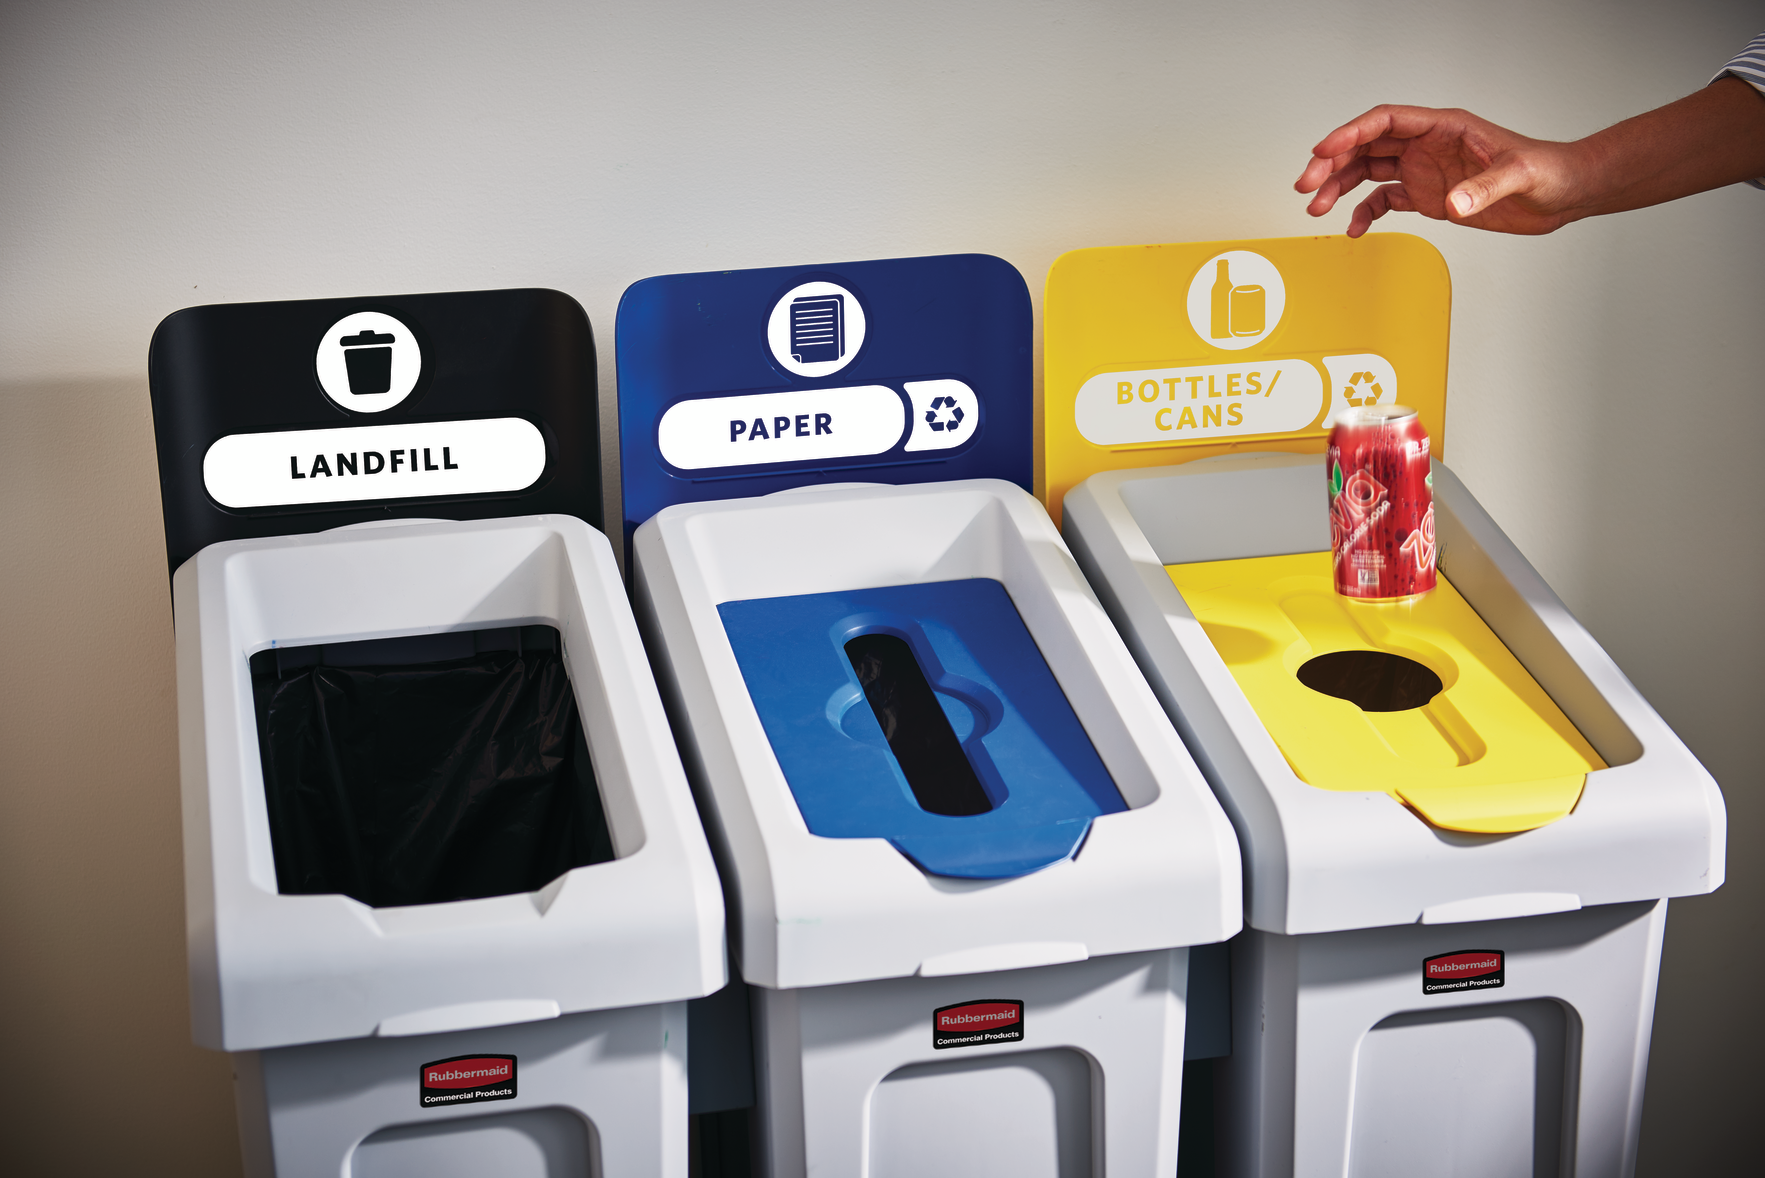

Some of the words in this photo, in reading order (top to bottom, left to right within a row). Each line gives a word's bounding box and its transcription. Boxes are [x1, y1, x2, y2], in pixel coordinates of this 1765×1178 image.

[1116, 369, 1283, 405] BOTTLES/
[1154, 402, 1244, 432] CANS
[729, 412, 833, 443] PAPER
[290, 446, 459, 480] LANDFILL
[1341, 521, 1369, 554] CALORIE
[1366, 499, 1391, 524] SODA
[1430, 959, 1497, 974] Rubbermaid
[1426, 981, 1468, 991] Commercial
[1469, 978, 1501, 987] Products
[941, 1009, 1016, 1026] Rubbermaid
[937, 1034, 983, 1045] Commercial
[984, 1031, 1020, 1040] Products
[429, 1064, 508, 1082] Rubbermaid
[424, 1091, 474, 1103] Commercial
[475, 1088, 513, 1098] Products
